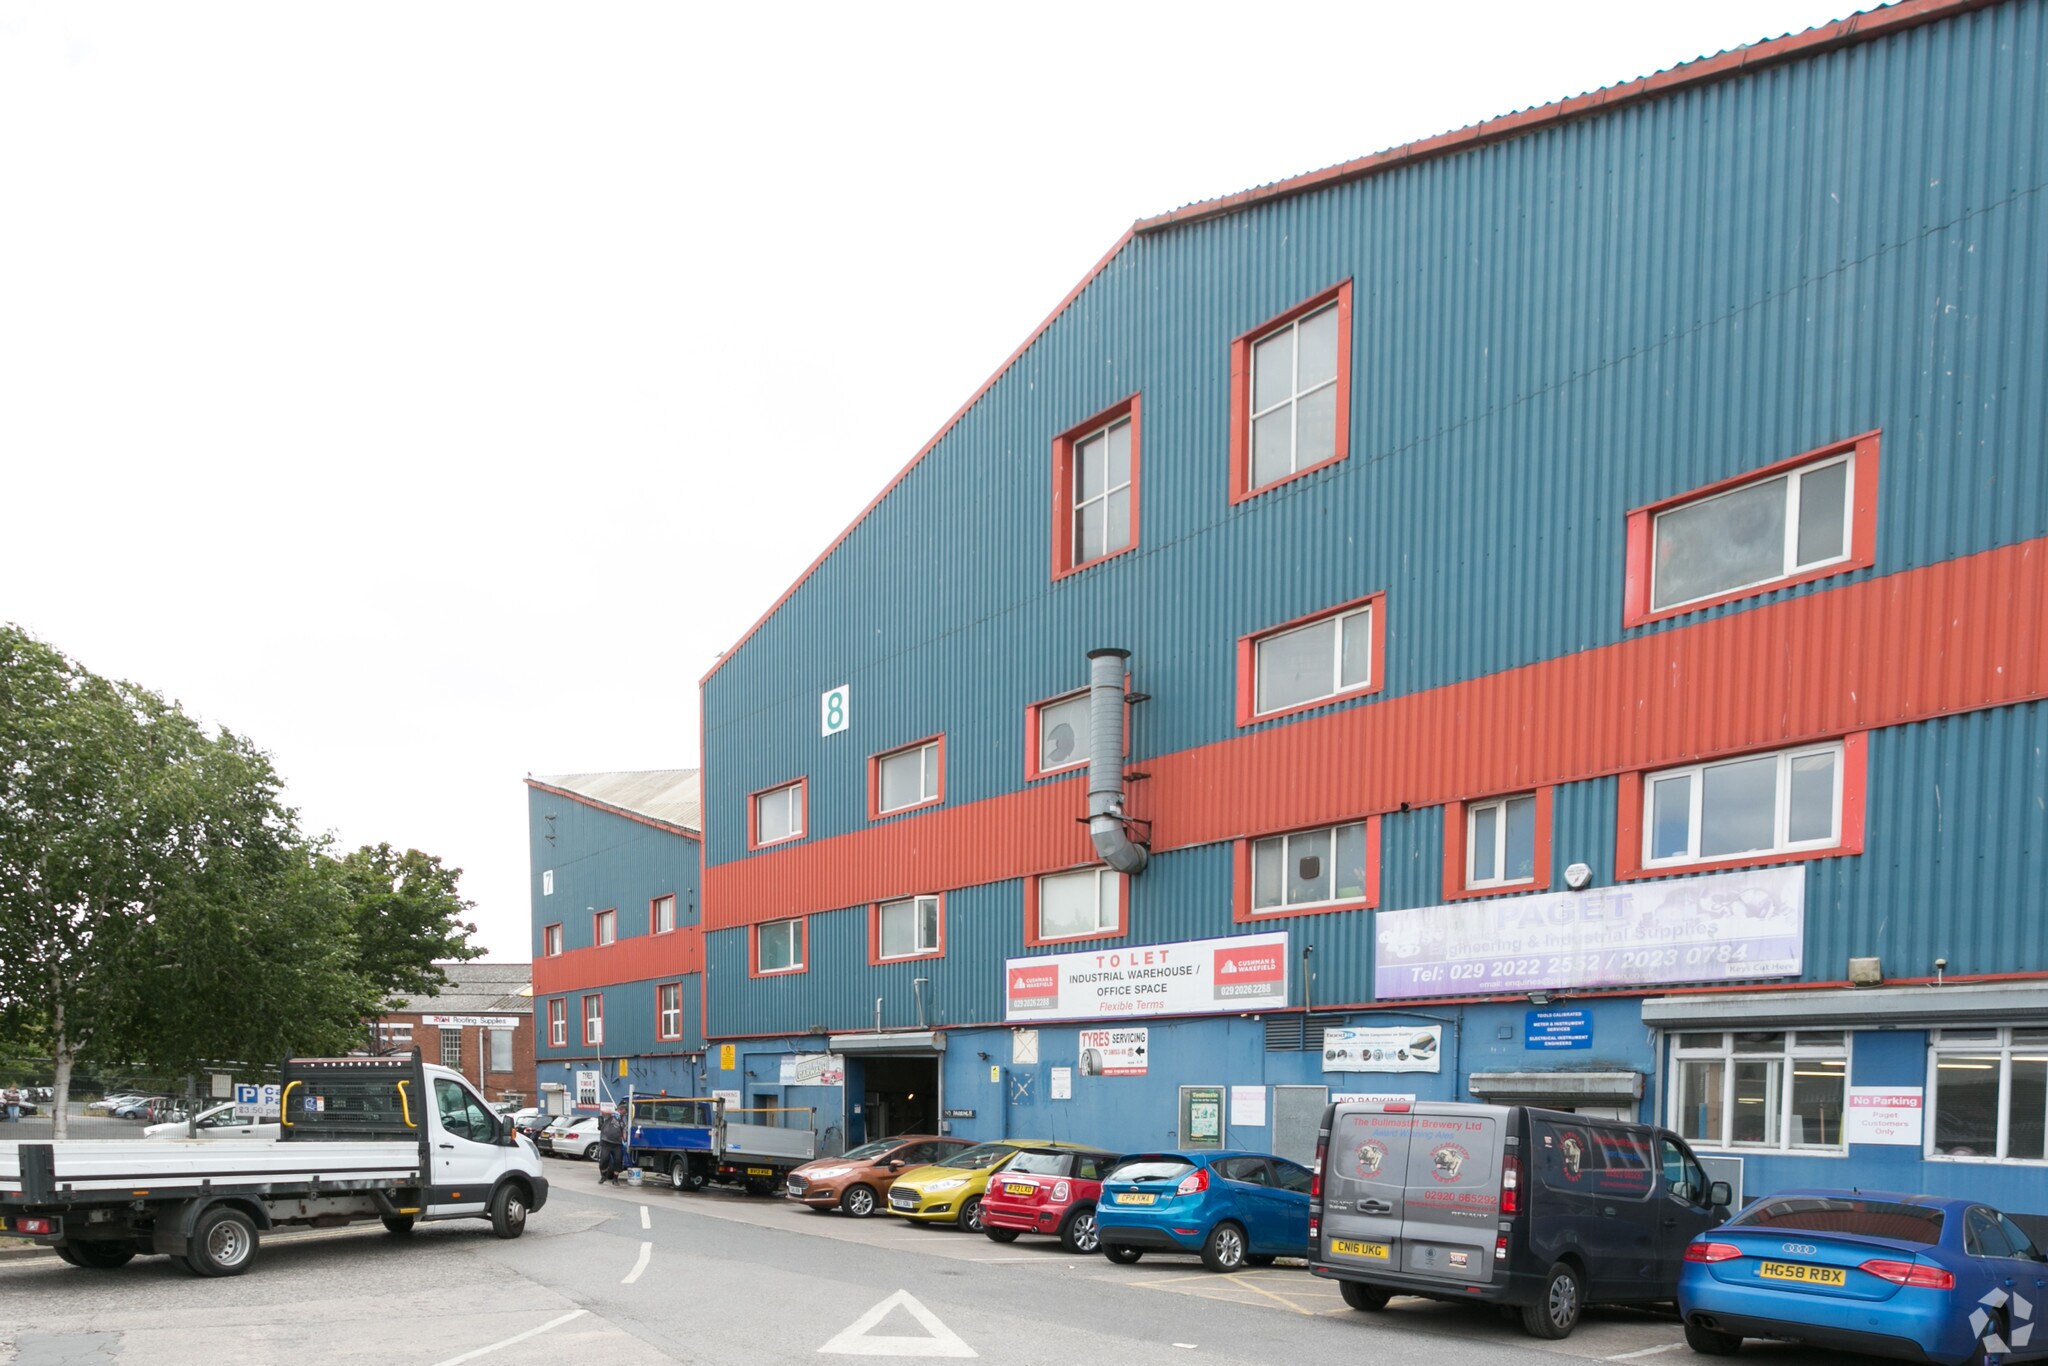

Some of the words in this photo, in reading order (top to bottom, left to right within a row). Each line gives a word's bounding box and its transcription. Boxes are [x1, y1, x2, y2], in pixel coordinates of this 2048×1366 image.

[828, 692, 843, 729] 8
[1497, 892, 1634, 929] PAGET
[1528, 934, 1539, 947] &
[1545, 928, 1628, 947] Industrial
[1635, 920, 1719, 941] Supplies
[1096, 953, 1121, 969] TO
[1130, 950, 1170, 966] LET
[1238, 959, 1269, 968] CUSHMAN
[1411, 966, 1444, 982] Tel:
[1450, 962, 1485, 980] 029
[1491, 959, 1540, 977] 2022
[1623, 949, 1678, 968] 2023
[1686, 943, 1749, 965] 0784
[1069, 971, 1124, 984] INDUSTRIAL
[1127, 966, 1192, 980] WAREHOUSE
[1238, 963, 1276, 973] WAKEFIELD
[1097, 985, 1131, 997] OFFICE
[1134, 983, 1168, 995] SPACE
[1221, 986, 1234, 996] 029
[1235, 985, 1252, 995] 2026
[1253, 984, 1271, 994] 2288
[1099, 1001, 1133, 1012] Flexible
[1136, 999, 1164, 1010] Terms
[453, 1016, 476, 1025] Roofing
[480, 1017, 506, 1025] Supplies
[1081, 1031, 1110, 1047] TYRES
[1112, 1032, 1146, 1044] SERVICING
[242, 1087, 255, 1102] P
[265, 1087, 280, 1096] Ca
[1854, 1096, 1870, 1105] No
[1873, 1096, 1918, 1107] Parking
[1873, 1111, 1898, 1119] Paget
[1354, 1118, 1369, 1127] The
[1371, 1118, 1419, 1128] Bullmastiff
[1422, 1119, 1462, 1131] Brewery
[1465, 1121, 1482, 1131] Ltd
[1861, 1119, 1909, 1127] Customers
[1875, 1128, 1895, 1136] Only
[1424, 1191, 1454, 1201] 02920
[1458, 1192, 1497, 1205] 665292
[1338, 1241, 1360, 1253] CN16
[1362, 1243, 1382, 1256] UKG
[1764, 1265, 1805, 1279] HG58
[1810, 1269, 1843, 1282] RBX
